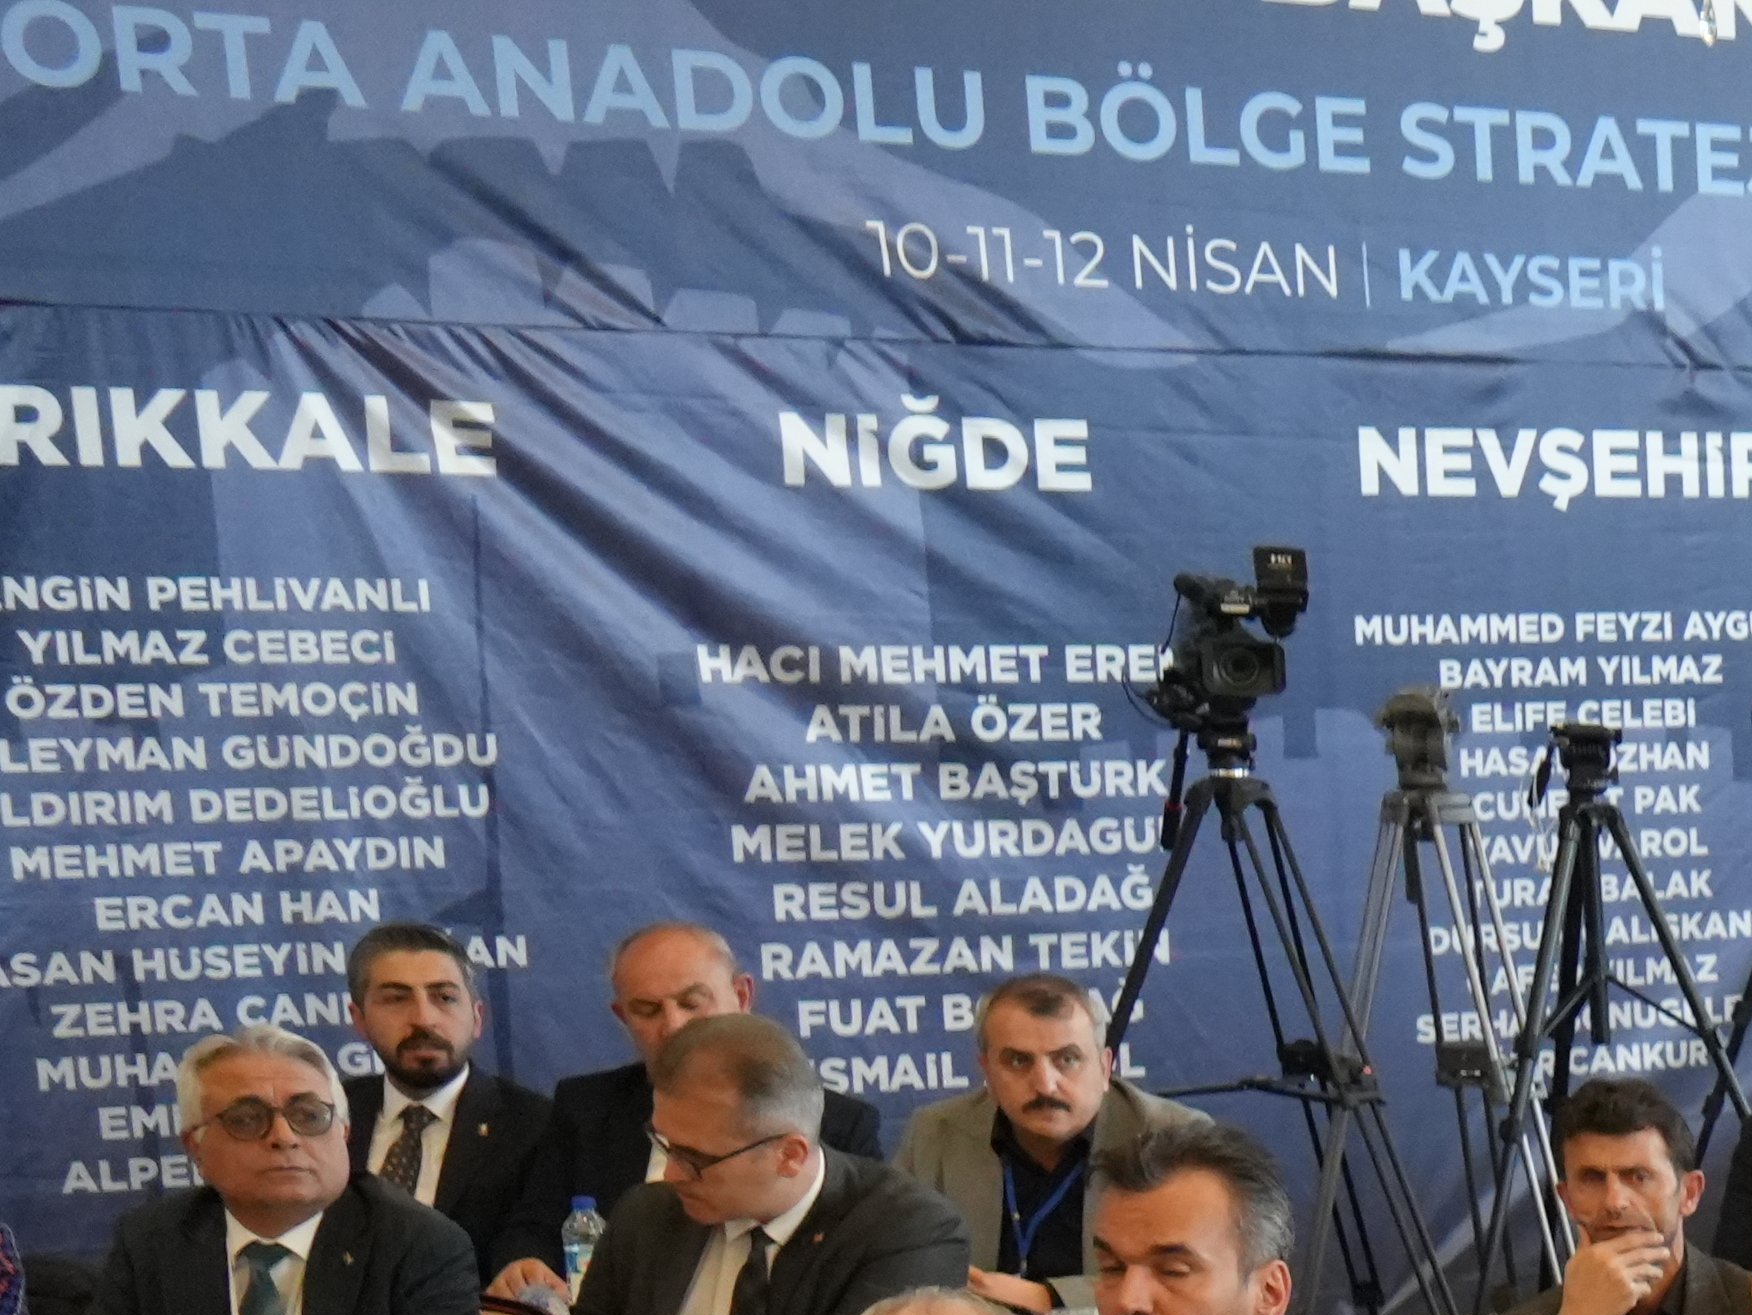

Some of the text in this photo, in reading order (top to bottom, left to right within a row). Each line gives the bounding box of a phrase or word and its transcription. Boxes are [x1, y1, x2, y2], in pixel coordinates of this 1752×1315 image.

[0, 0, 371, 111] ORTA
[399, 29, 985, 153] ANADOLU
[1025, 61, 1371, 175] BÖLGE
[864, 219, 1670, 316] 10-11-12 NİSAN KAYSERİ
[777, 393, 1093, 492] NİĞDE
[0, 575, 431, 613] NGİN PEHLİVANLI
[16, 629, 396, 665] YILMAZ CEBECİ
[1354, 613, 1565, 646] MUHAMMED
[693, 642, 820, 689] HACI
[838, 645, 1049, 685] MEHMET
[1439, 654, 1724, 690] BAYRAM YILMAZ
[5, 675, 419, 723] ÖZDEN TEMOÇİN
[970, 694, 1102, 743] ÖZER
[746, 763, 921, 803] AHMET
[1635, 785, 1702, 815] PAK
[10, 836, 446, 881] MEHMET APAYDIN
[730, 817, 910, 863] MELEK
[93, 887, 381, 931] ERCAN HAN
[772, 864, 1153, 922] RESUL ALADAĞ
[760, 935, 1014, 981] RAMAZAN
[50, 992, 351, 1039] ZEHRA CAN
[797, 995, 926, 1038] FUAT
[62, 1154, 204, 1196] ALPE
